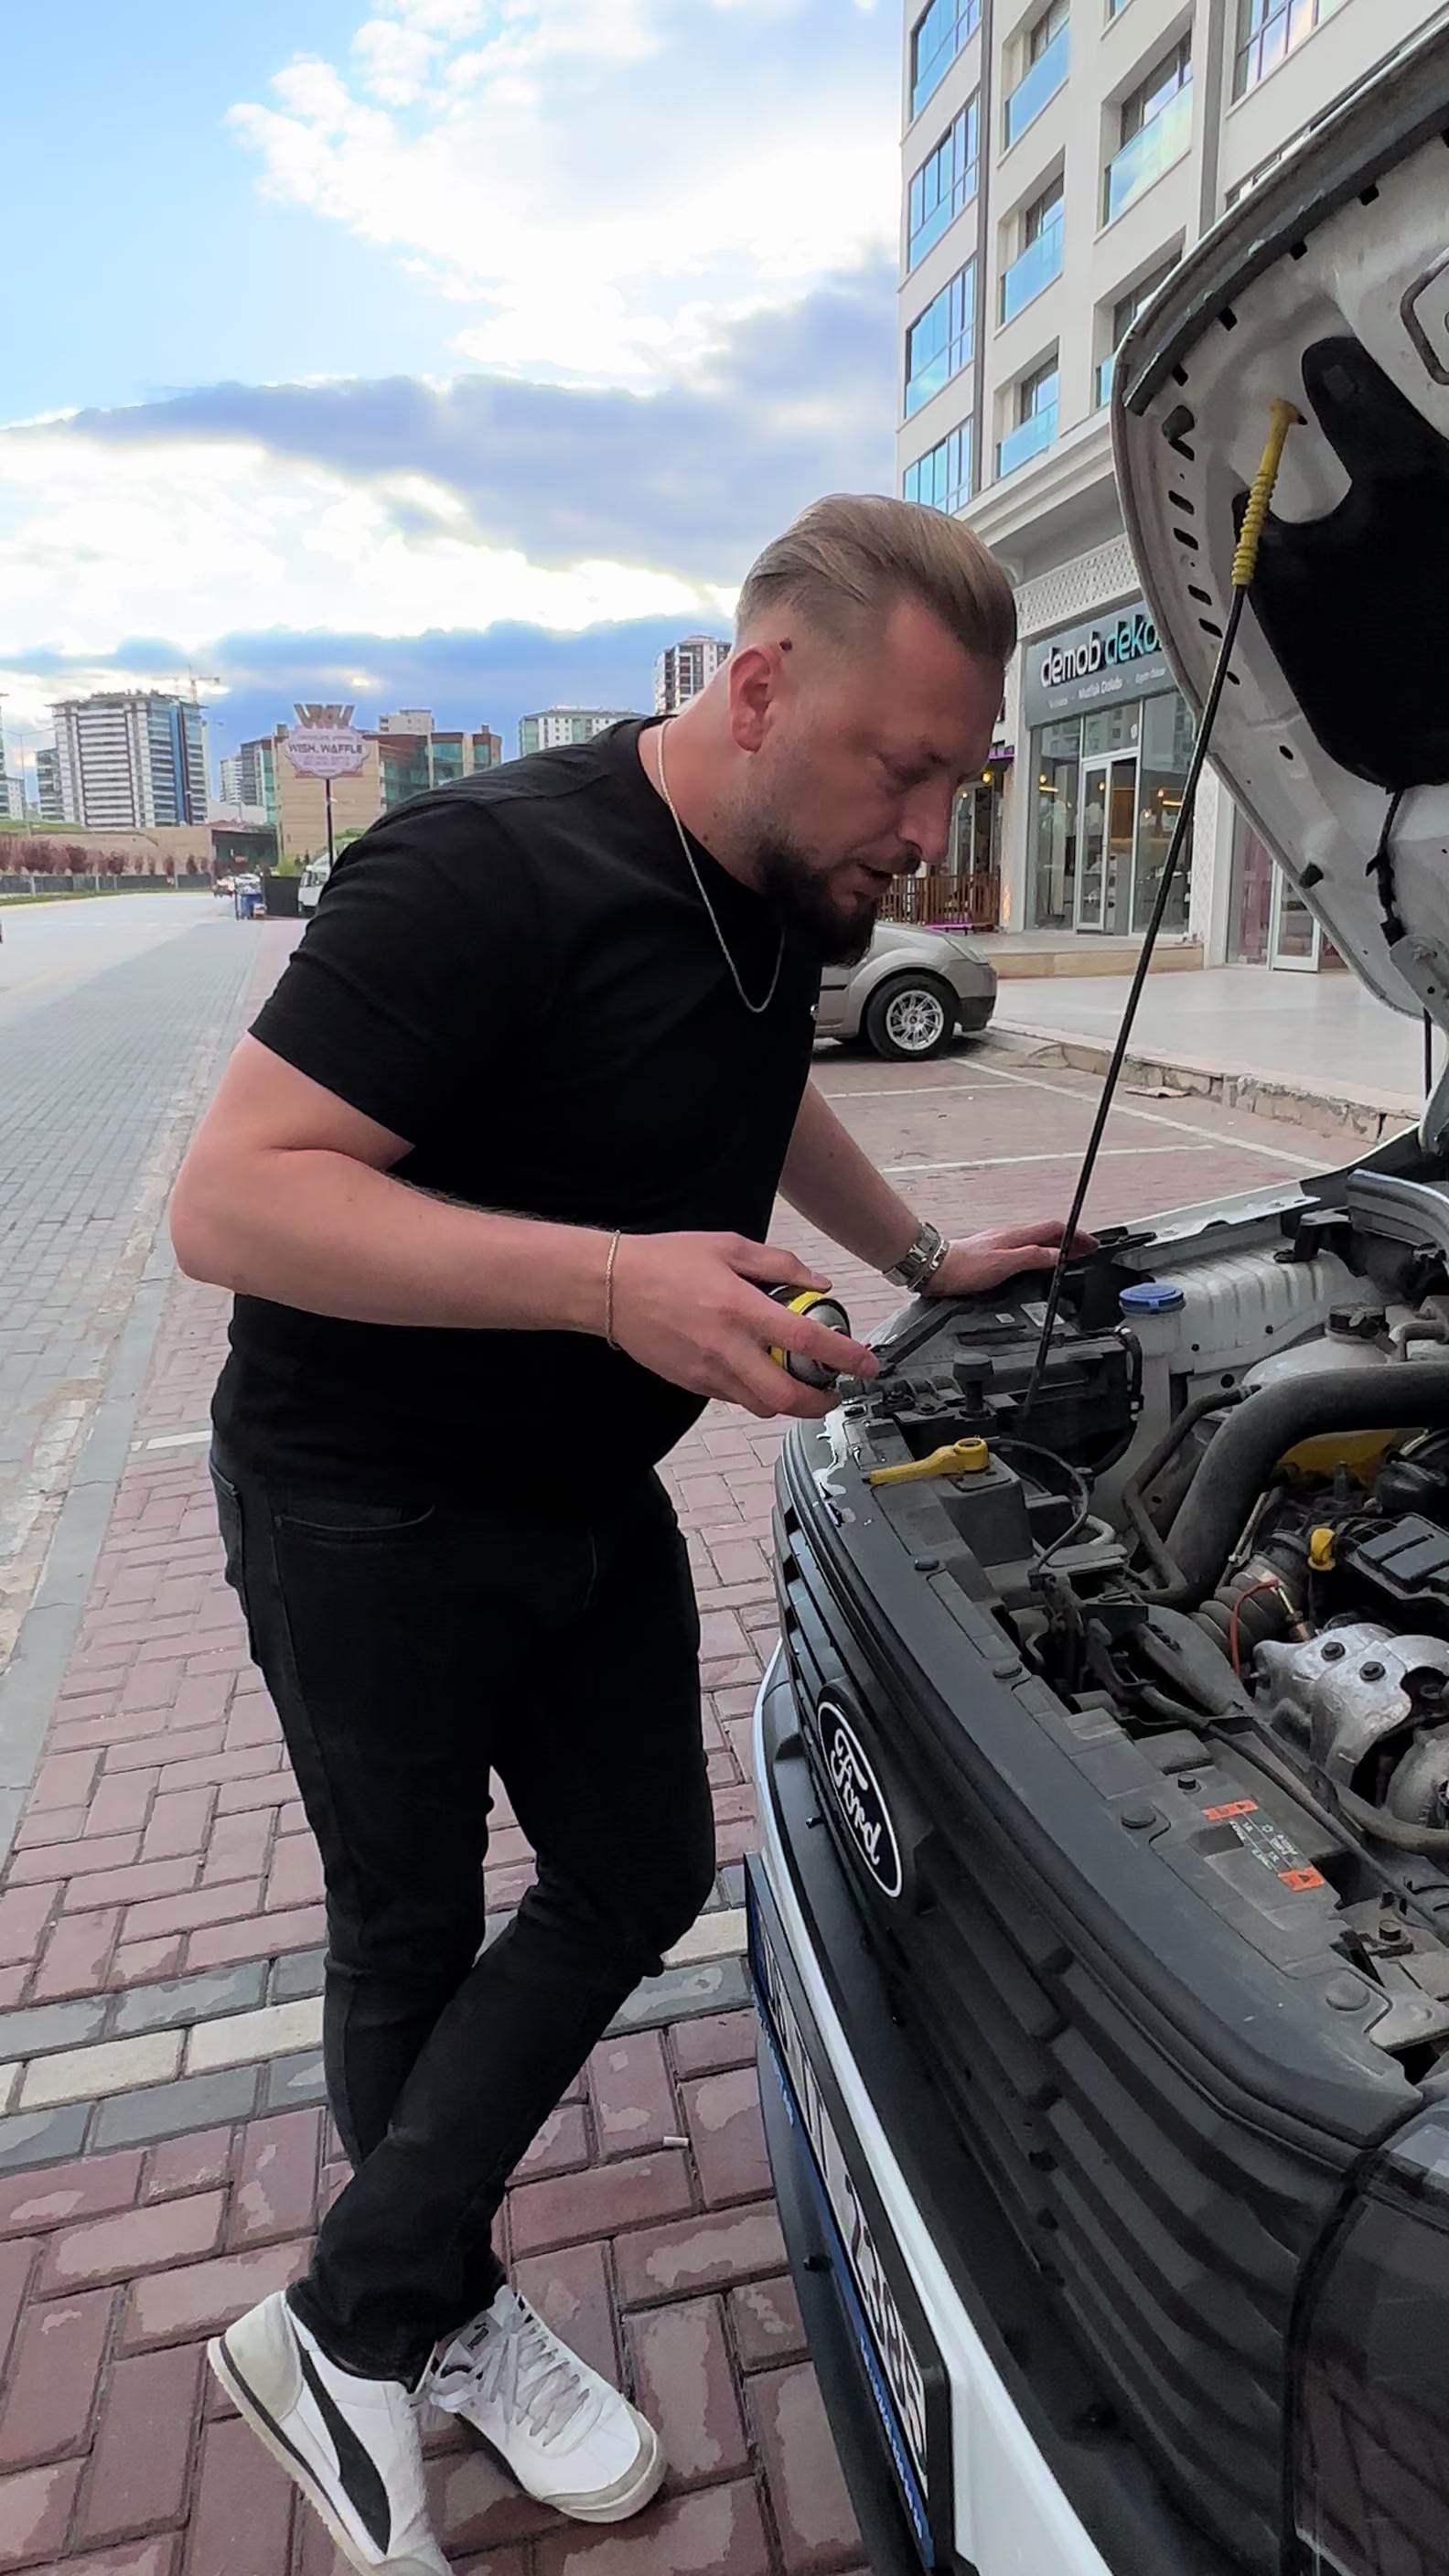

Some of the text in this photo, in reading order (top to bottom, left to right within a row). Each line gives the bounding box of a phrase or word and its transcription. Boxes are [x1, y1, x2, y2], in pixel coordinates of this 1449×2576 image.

[1041, 631, 1101, 688] demob
[320, 744, 363, 755] WAFFLE
[830, 1727, 882, 1866] Ford
